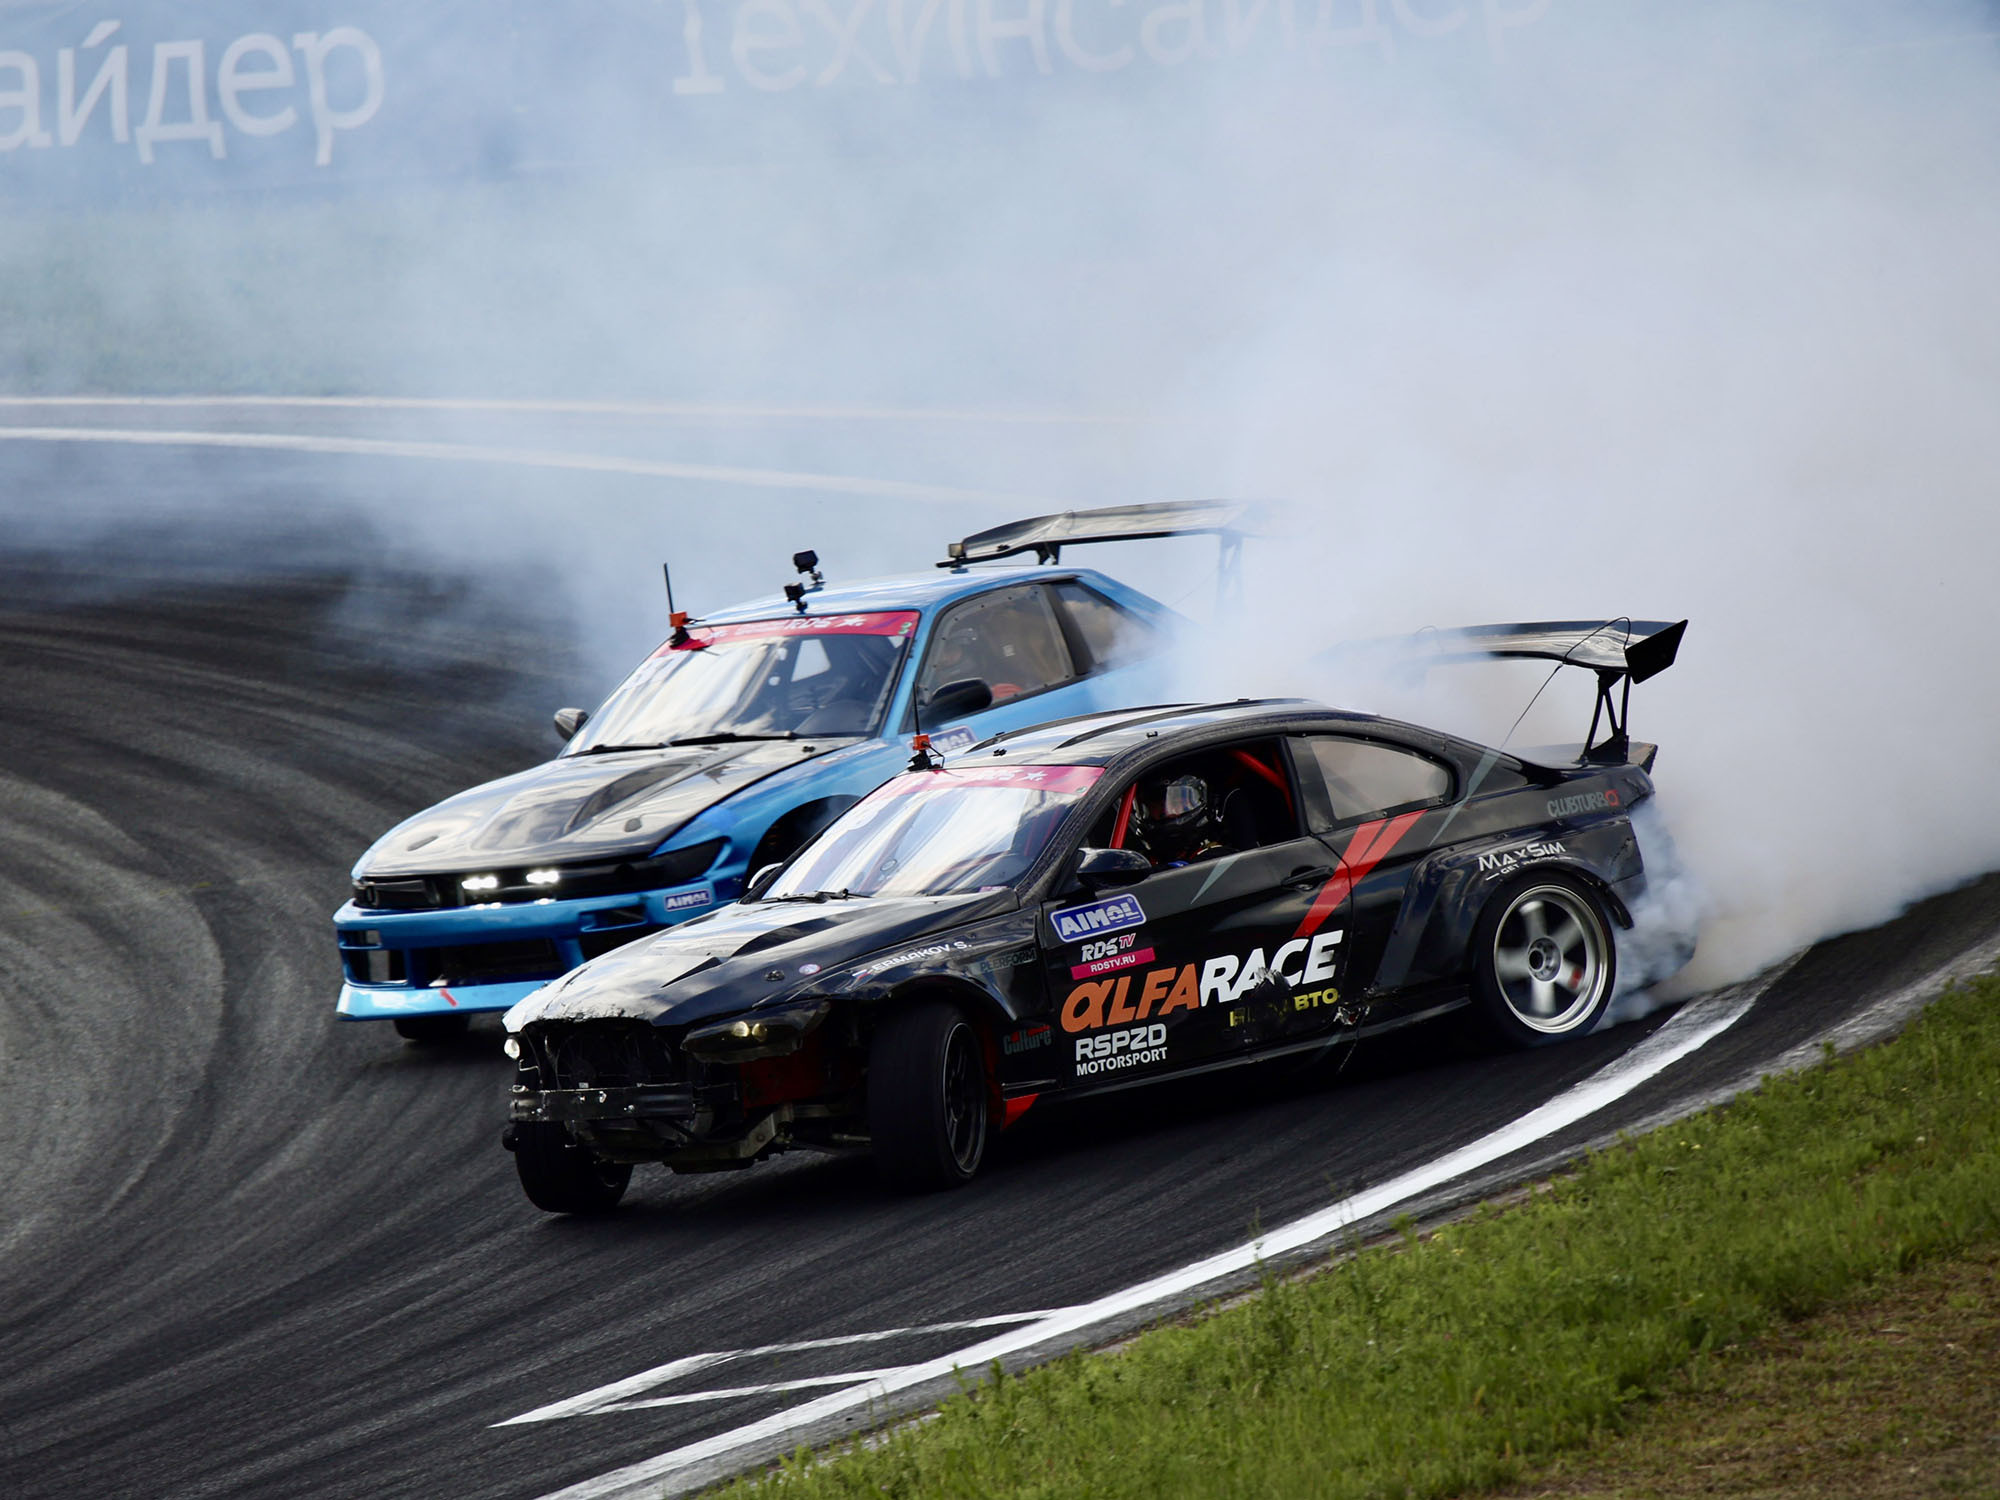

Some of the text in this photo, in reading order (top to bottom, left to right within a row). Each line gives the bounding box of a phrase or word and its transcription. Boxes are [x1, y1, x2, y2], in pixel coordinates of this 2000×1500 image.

[1061, 901, 1140, 937] AIMOL
[1090, 954, 1136, 973] RDSTV.RU
[1076, 1023, 1167, 1061] RSPZD
[1076, 1047, 1168, 1076] MOTORSPORT
